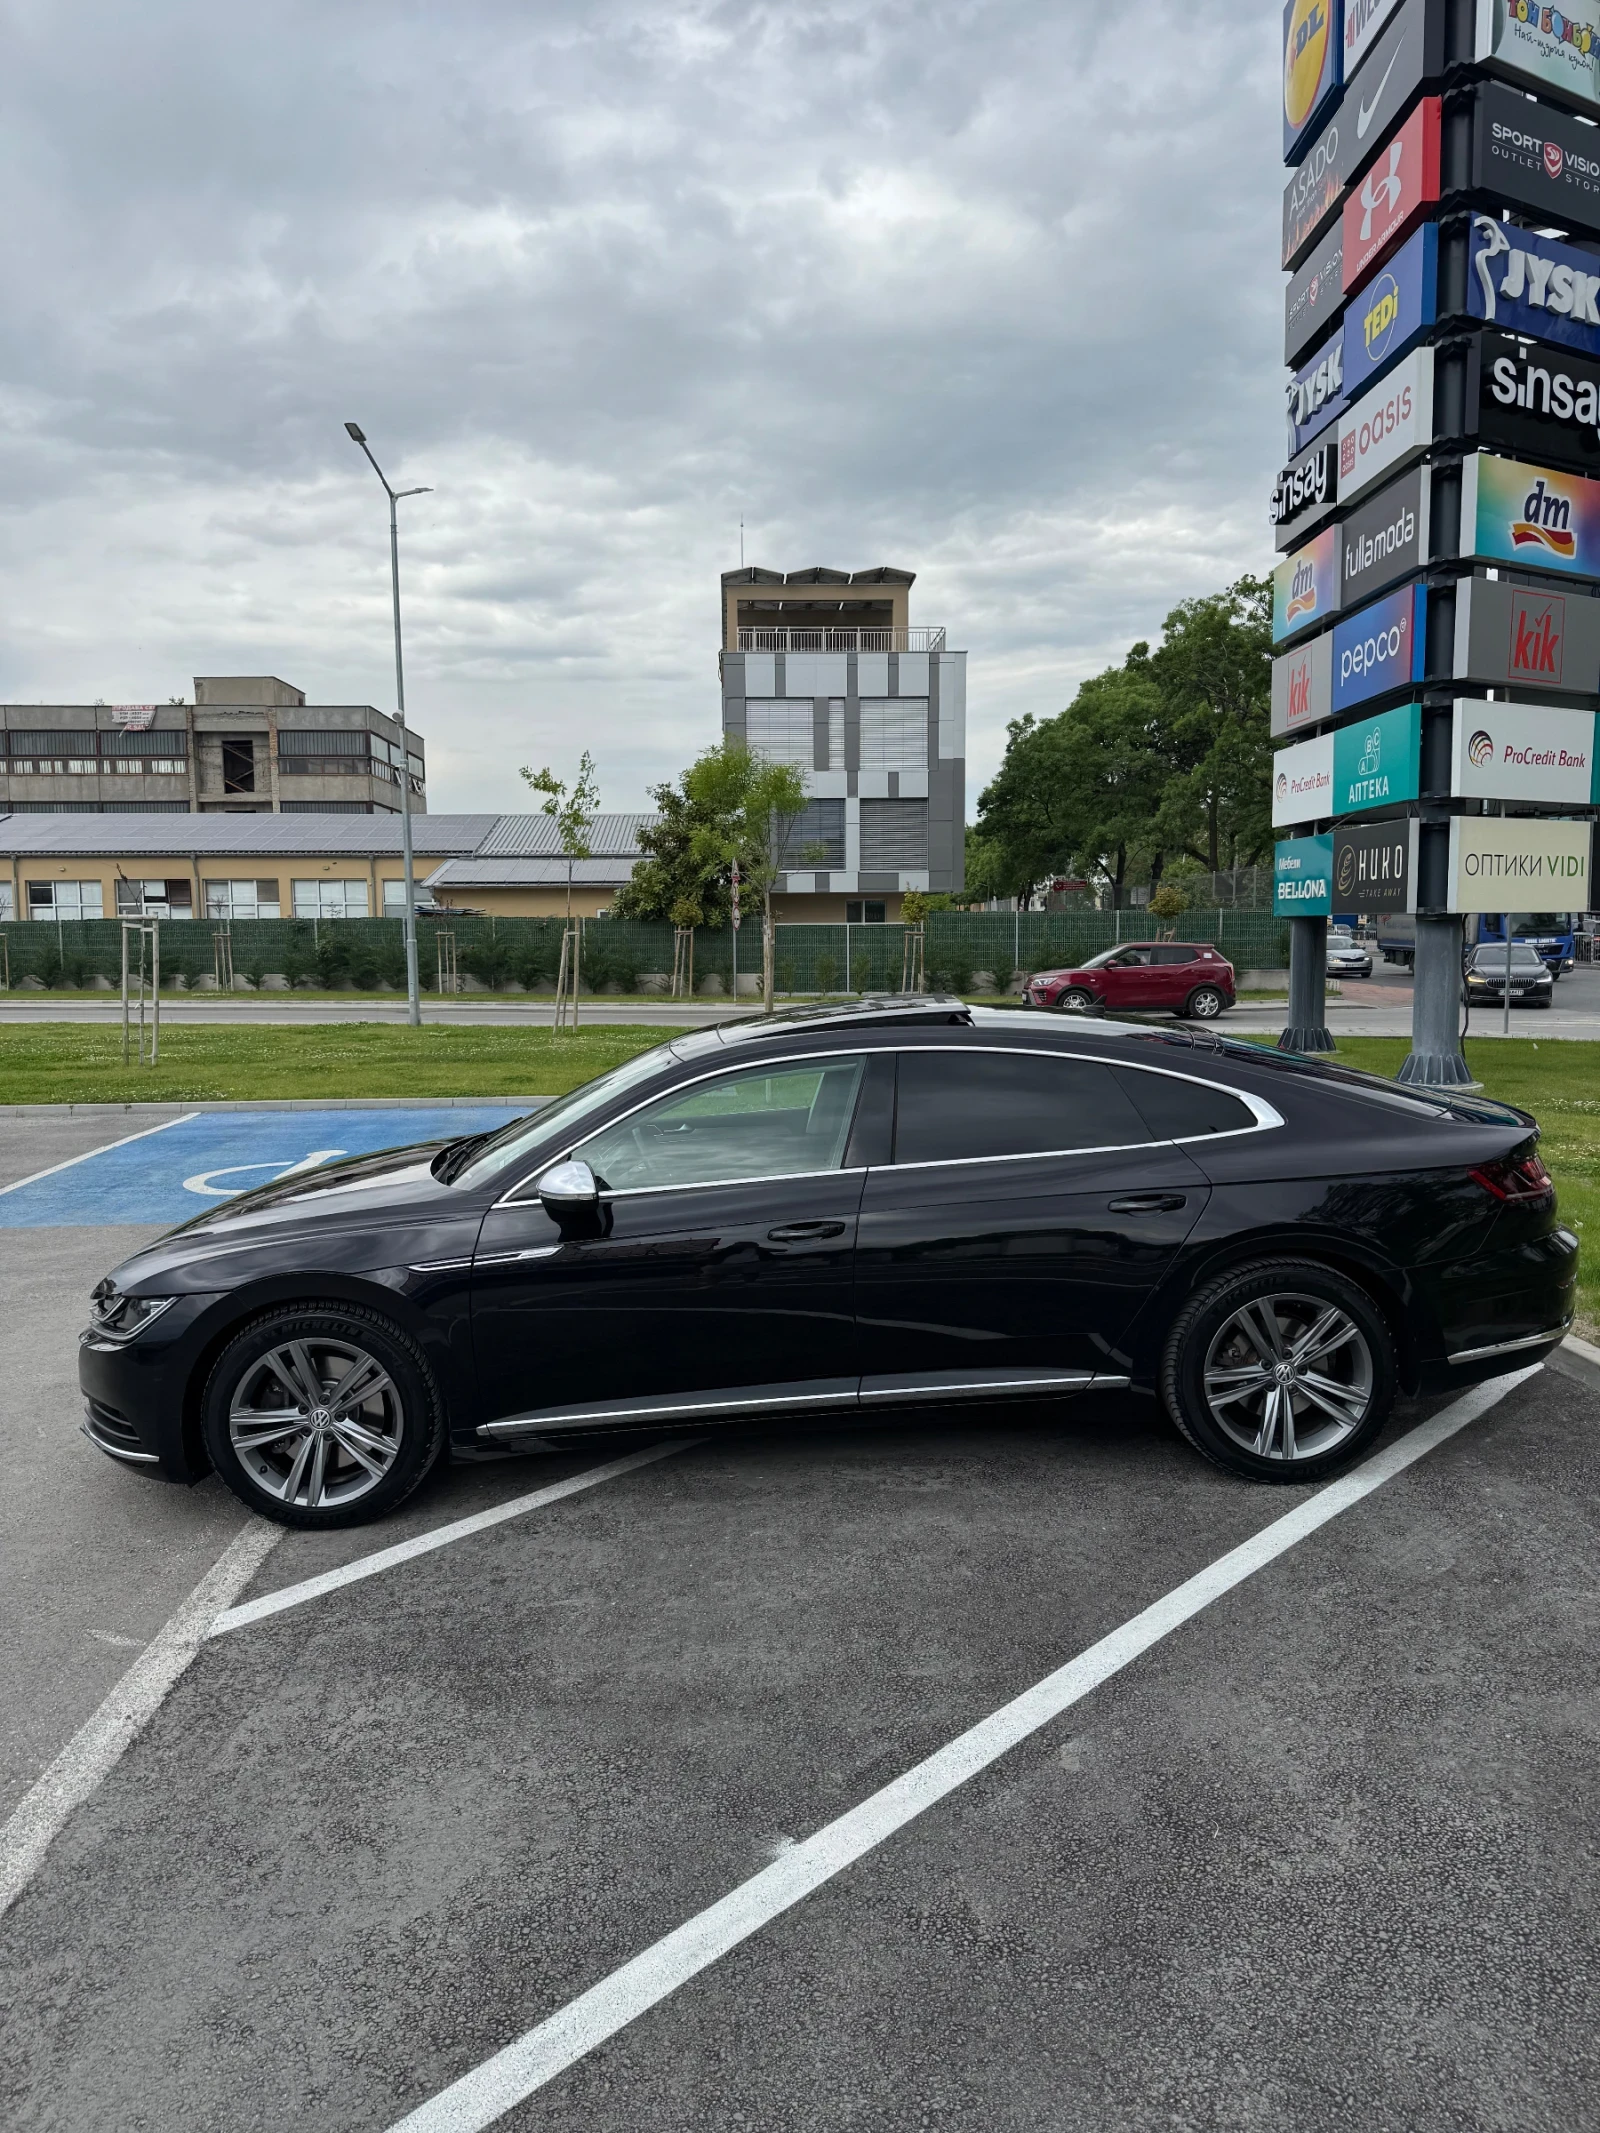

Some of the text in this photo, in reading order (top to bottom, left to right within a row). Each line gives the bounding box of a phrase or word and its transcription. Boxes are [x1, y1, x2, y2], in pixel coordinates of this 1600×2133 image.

[1491, 145, 1542, 171] OUTLET
[1492, 122, 1542, 153] SPORT
[1289, 126, 1339, 221] ASADO
[1356, 210, 1404, 273] UNDER ARMOUR
[1500, 248, 1600, 327] JYSK
[1295, 342, 1343, 426] JYSK
[1492, 346, 1600, 441] sinsa
[1358, 385, 1412, 455] oasis
[1269, 444, 1328, 525] sinsay
[1524, 480, 1570, 531] dm
[1345, 506, 1415, 581] fullamoda
[1292, 559, 1314, 599] dm
[1513, 603, 1560, 673] kik
[1288, 655, 1311, 718] kik
[1503, 745, 1586, 768] ProCredit Bank
[1291, 771, 1331, 794] ProCredit Bank
[1348, 775, 1390, 804] АПТЕКА
[1278, 856, 1301, 871] Мебели
[1465, 853, 1585, 877] ОПТИКИ VIDI
[1277, 878, 1327, 900] BELLONA
[1366, 888, 1402, 898] TAKE AWAY
[281, 1320, 363, 1338] MICHELIN
